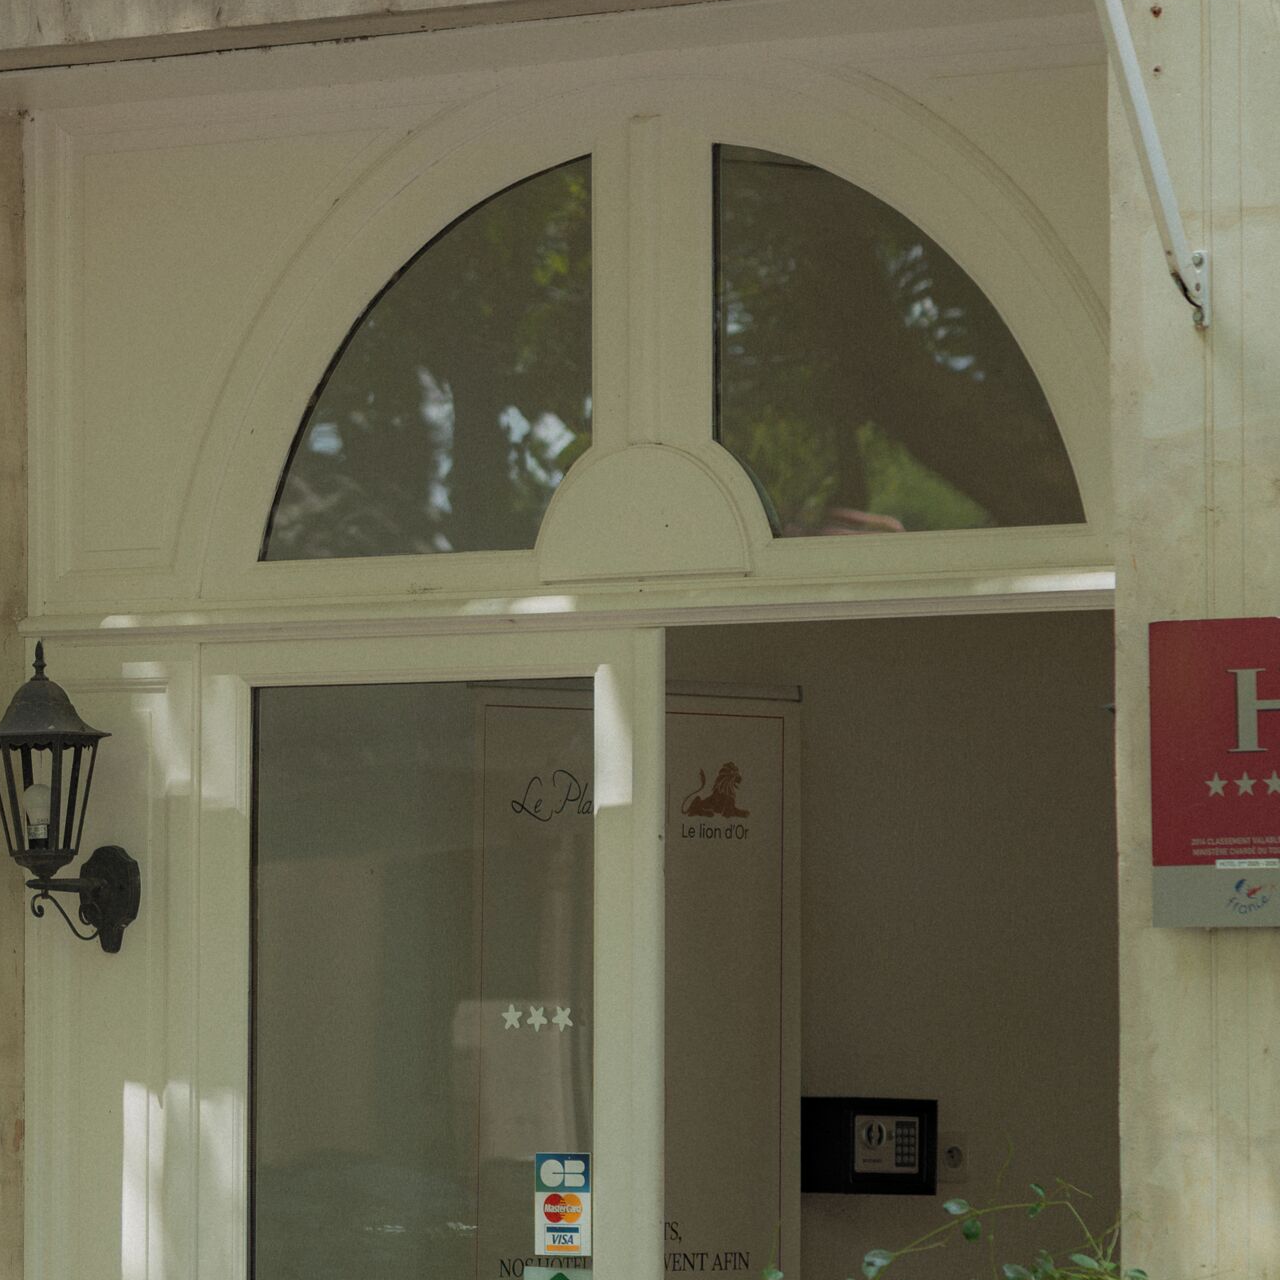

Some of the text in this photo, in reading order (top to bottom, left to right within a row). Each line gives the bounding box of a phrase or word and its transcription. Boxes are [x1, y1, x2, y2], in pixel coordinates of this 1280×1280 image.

[512, 776, 553, 822] Le
[682, 824, 750, 840] Le lion d'Or
[551, 1233, 574, 1245] VISA
[712, 1251, 750, 1271] AFIN
